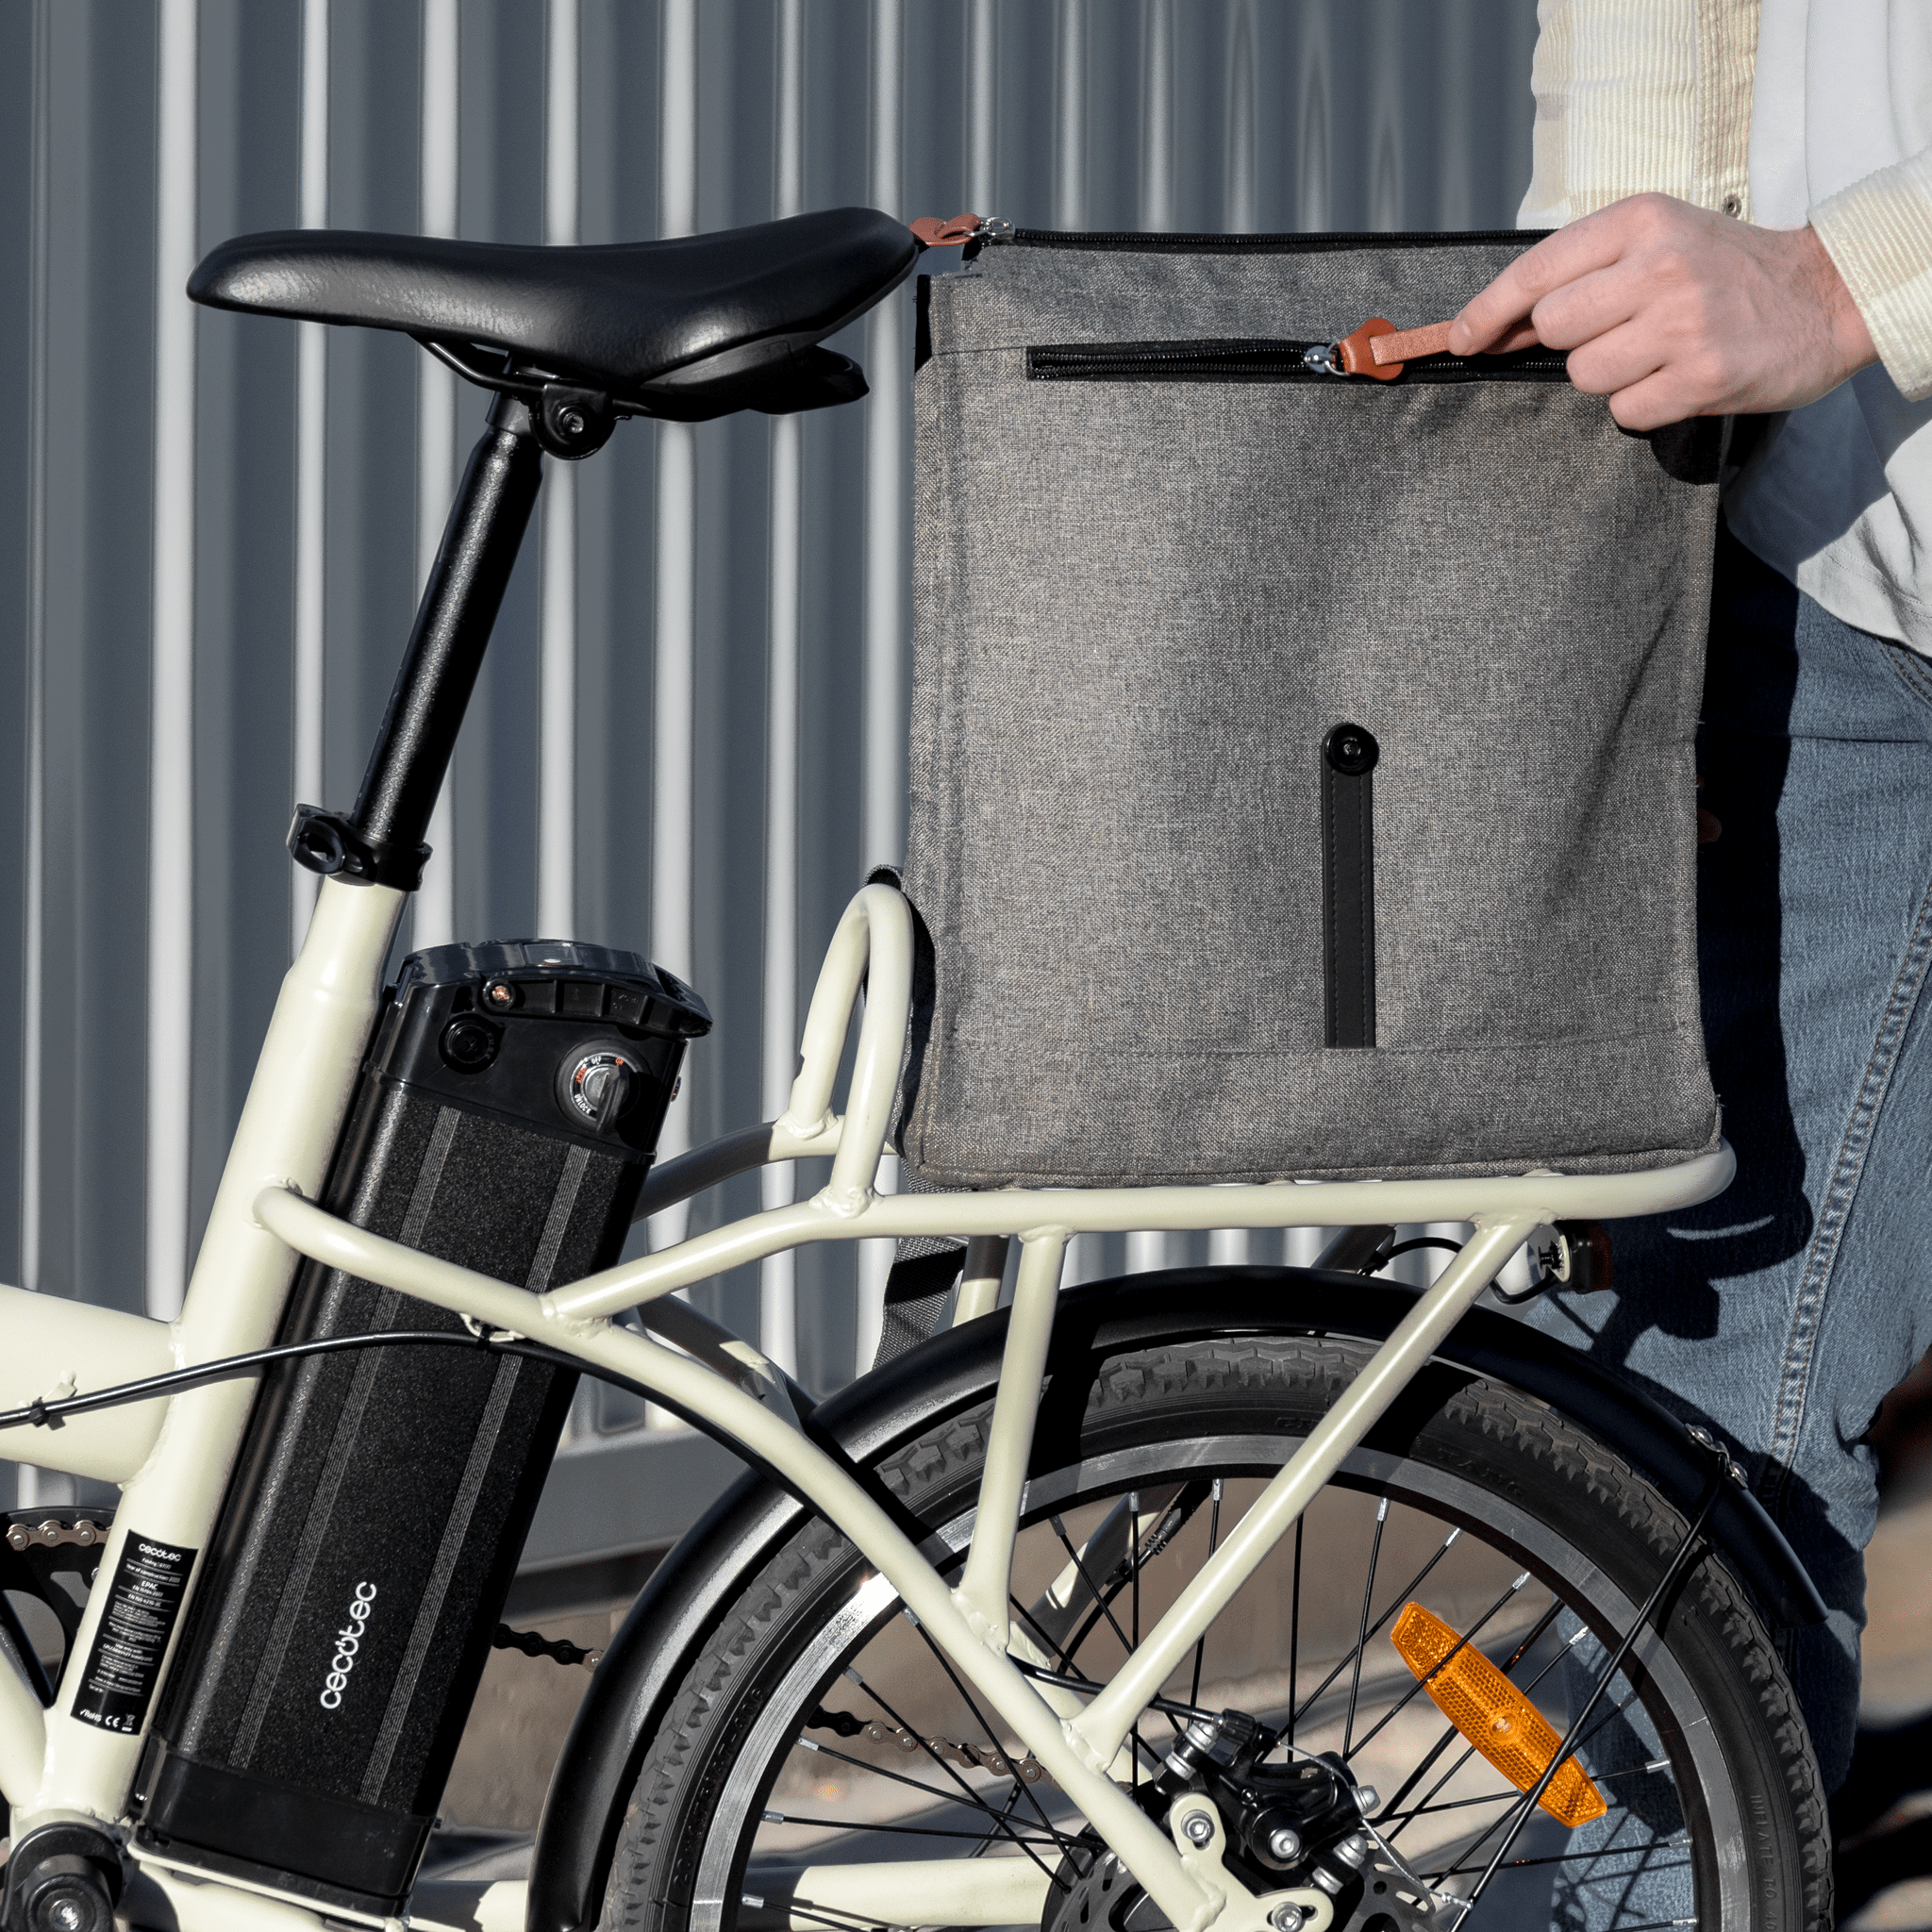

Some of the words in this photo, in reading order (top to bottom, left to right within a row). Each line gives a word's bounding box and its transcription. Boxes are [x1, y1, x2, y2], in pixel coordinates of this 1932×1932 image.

[574, 1093, 591, 1115] UNLOCK
[141, 1580, 158, 1591] EPAC
[1750, 1795, 1774, 1864] INFLATE
[1762, 1877, 1777, 1900] TO
